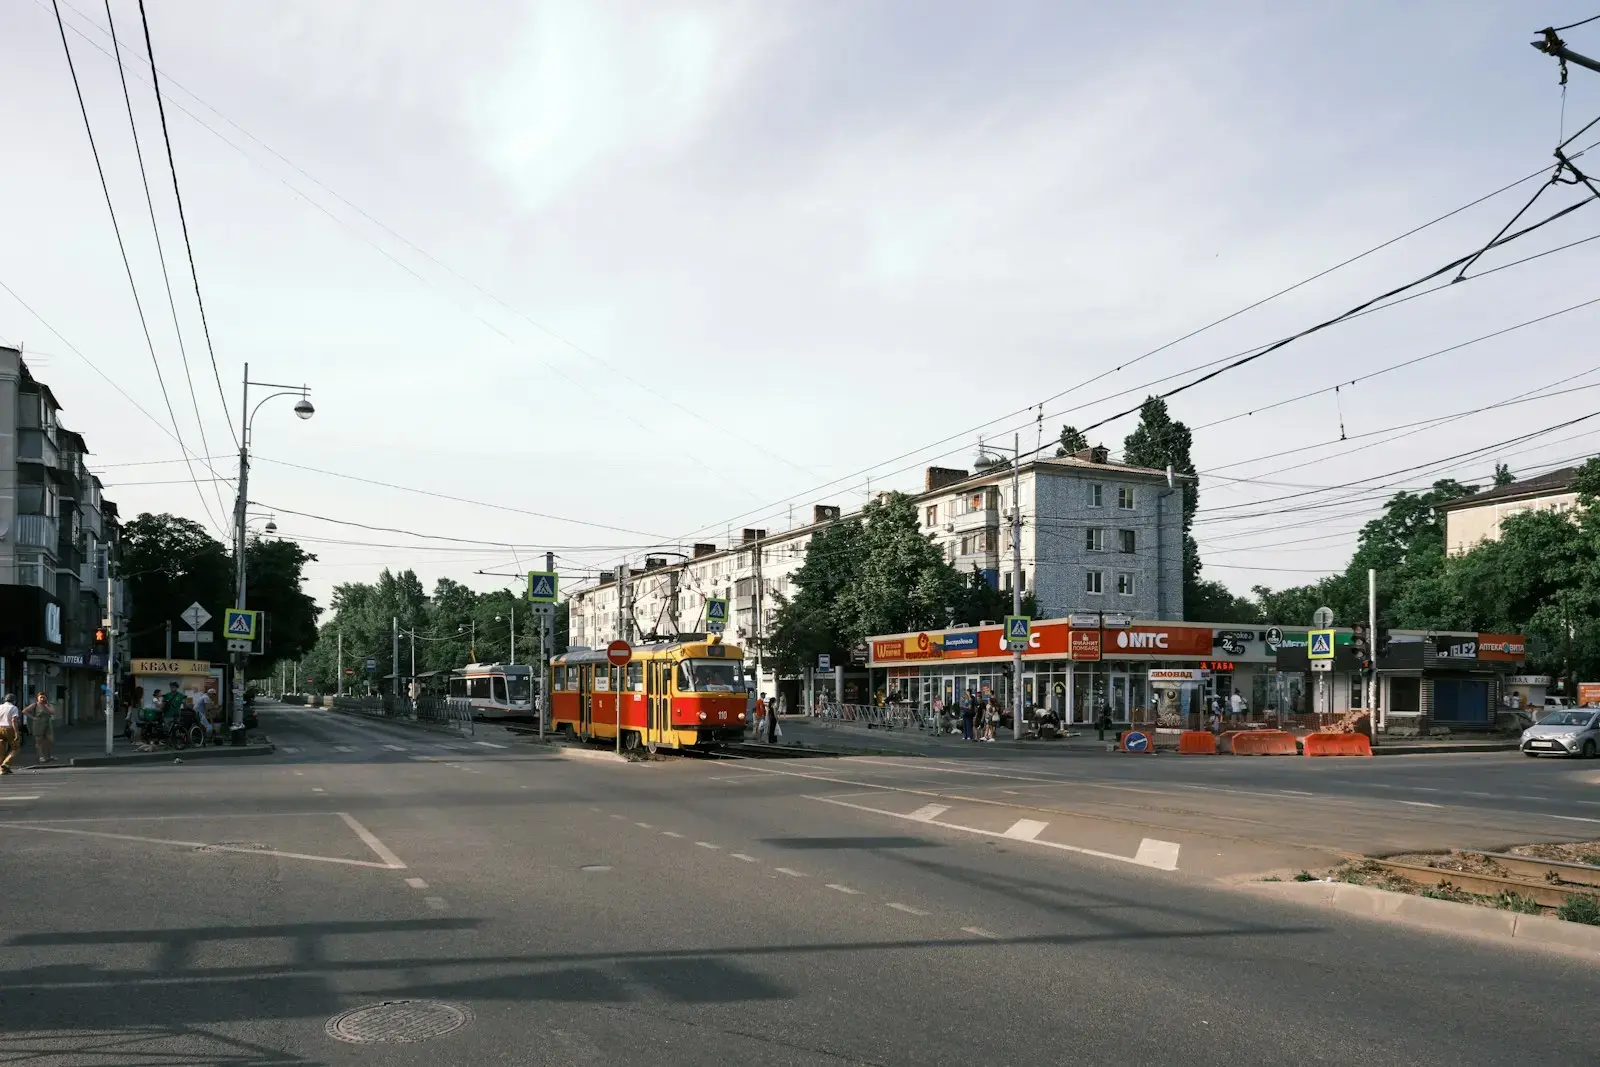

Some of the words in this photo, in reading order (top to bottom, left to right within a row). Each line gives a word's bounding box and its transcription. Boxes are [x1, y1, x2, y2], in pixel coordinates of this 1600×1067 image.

[1129, 632, 1168, 648] МТС
[1222, 639, 1233, 651] 24
[1479, 643, 1503, 651] АПТЕКА
[1509, 644, 1525, 652] ВИТА
[140, 662, 180, 671] КВАС
